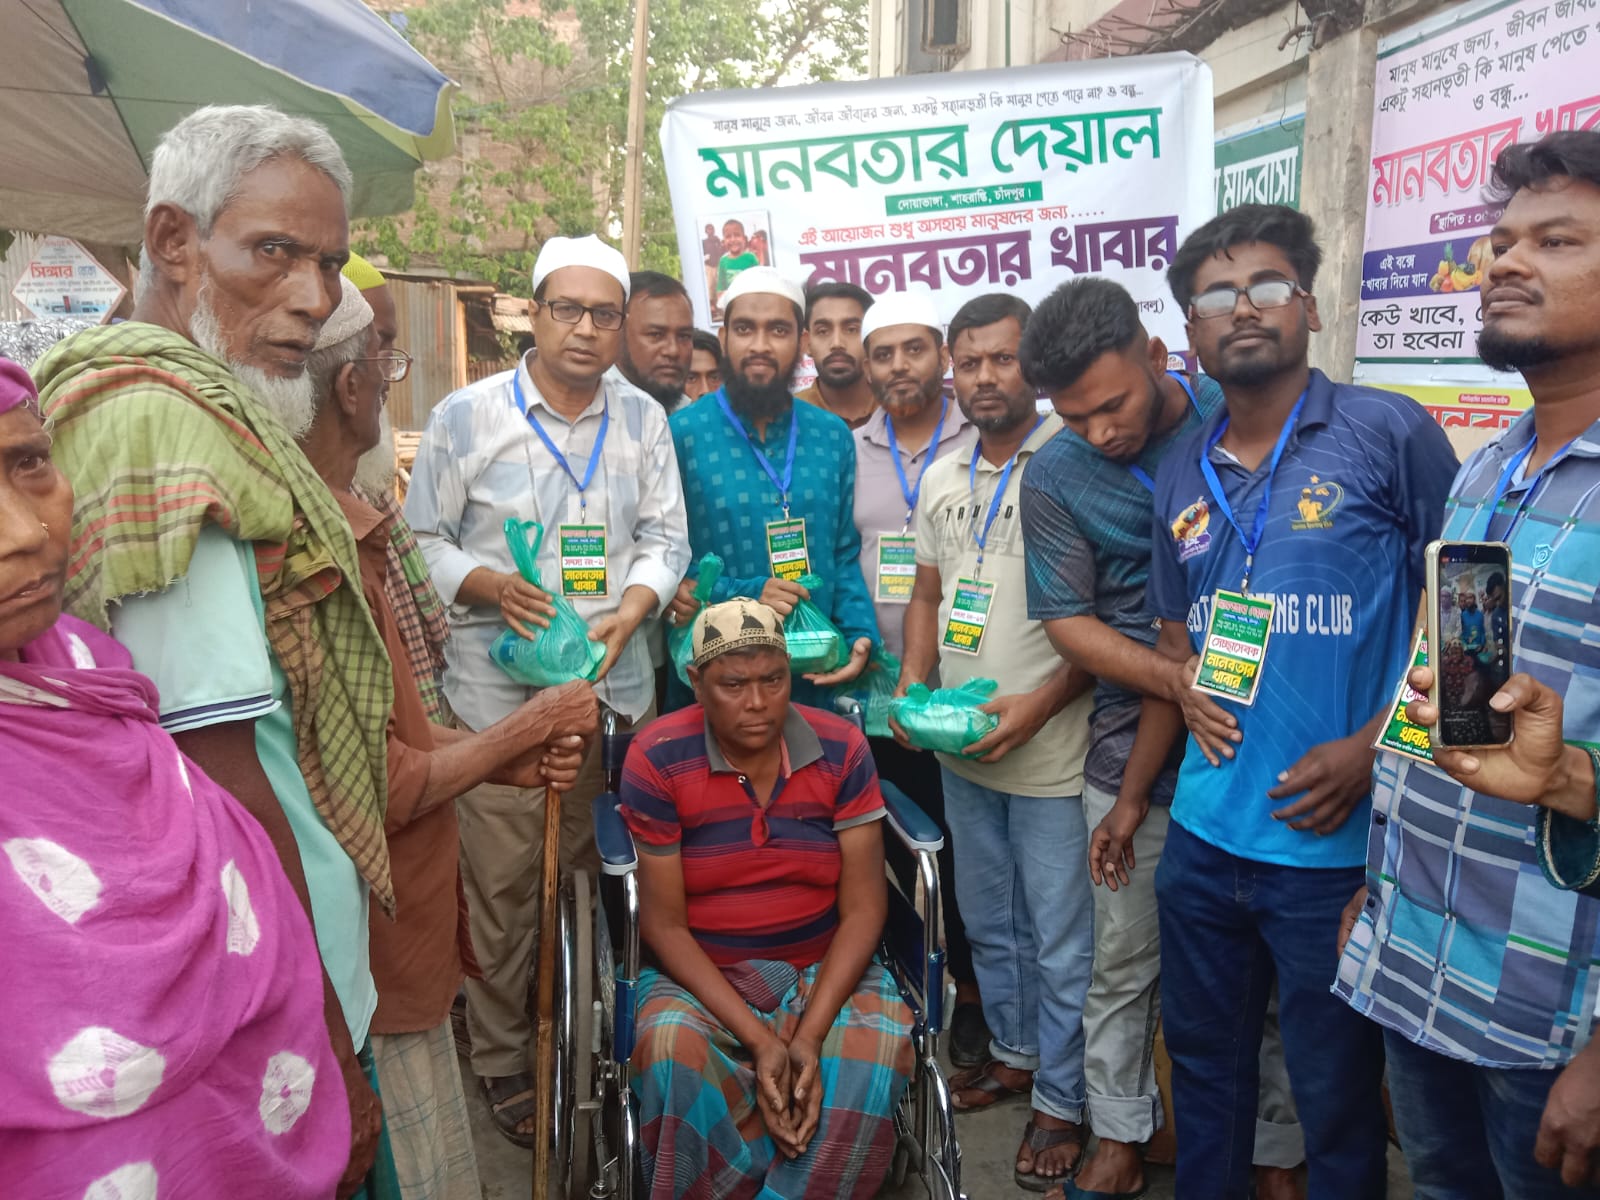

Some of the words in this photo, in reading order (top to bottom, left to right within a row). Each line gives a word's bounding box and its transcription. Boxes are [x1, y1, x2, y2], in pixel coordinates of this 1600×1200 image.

[1390, 59, 1418, 83] মানুষ
[1506, 10, 1550, 38] জীবন
[1379, 87, 1407, 112] একটু
[1475, 56, 1494, 83] কি
[1499, 43, 1538, 72] মানুষ
[1542, 24, 1590, 59] পেতে
[1473, 94, 1484, 111] ও
[698, 124, 969, 198] মানবতার
[991, 107, 1163, 173] দেয়াল
[798, 227, 817, 246] এই
[821, 222, 885, 243] আয়োজন
[889, 221, 915, 240] শুধু
[919, 215, 967, 234] অসহায়
[971, 209, 1034, 231] মানুষদের
[1050, 215, 1179, 274] খাবার
[1380, 253, 1394, 271] এই
[1412, 272, 1428, 288] যান
[1361, 303, 1402, 327] কেউ
[1373, 332, 1395, 350] তা
[1402, 331, 1465, 351] হবেনা
[1305, 594, 1352, 635] CLUB
[1206, 653, 1257, 678] মানবতার
[1212, 669, 1243, 690] খাবার
